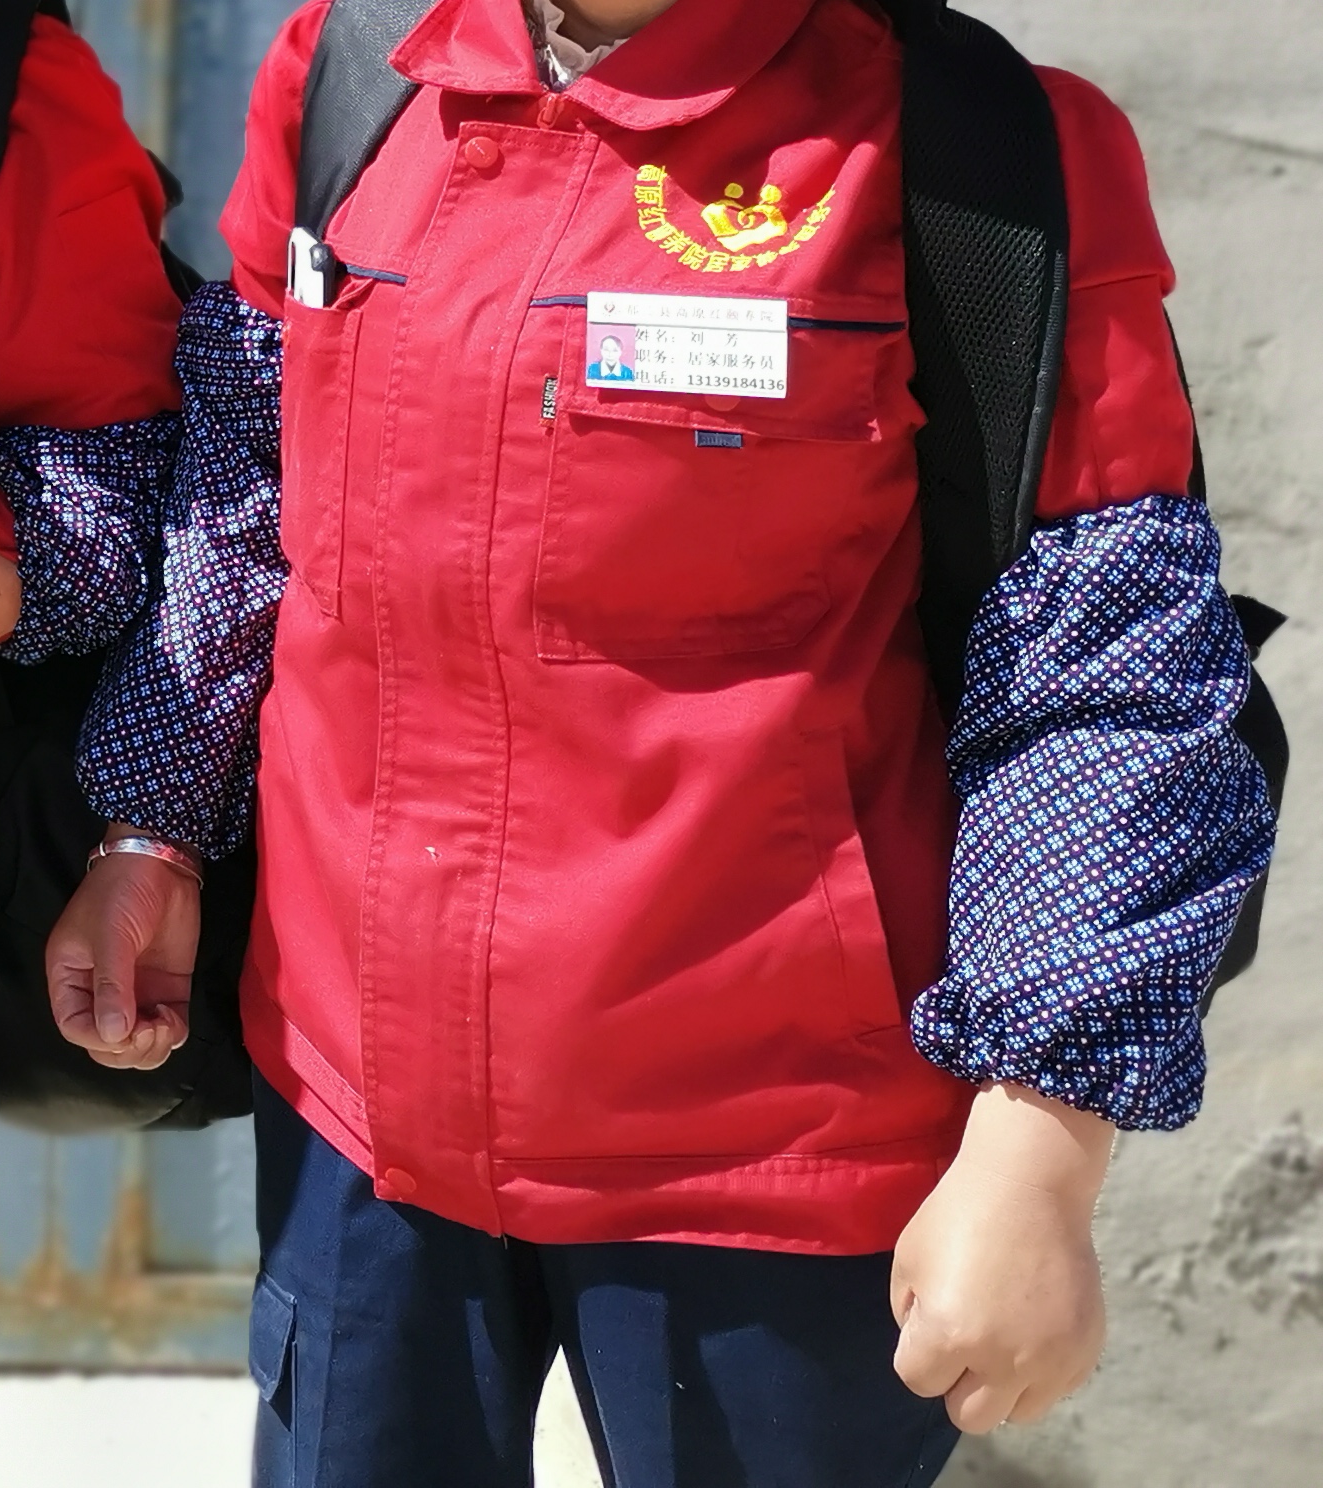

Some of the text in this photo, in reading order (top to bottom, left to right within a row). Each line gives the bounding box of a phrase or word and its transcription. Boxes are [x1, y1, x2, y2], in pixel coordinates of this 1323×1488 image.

[688, 351, 774, 370] 居家服务员
[687, 374, 785, 391] 13139184136
